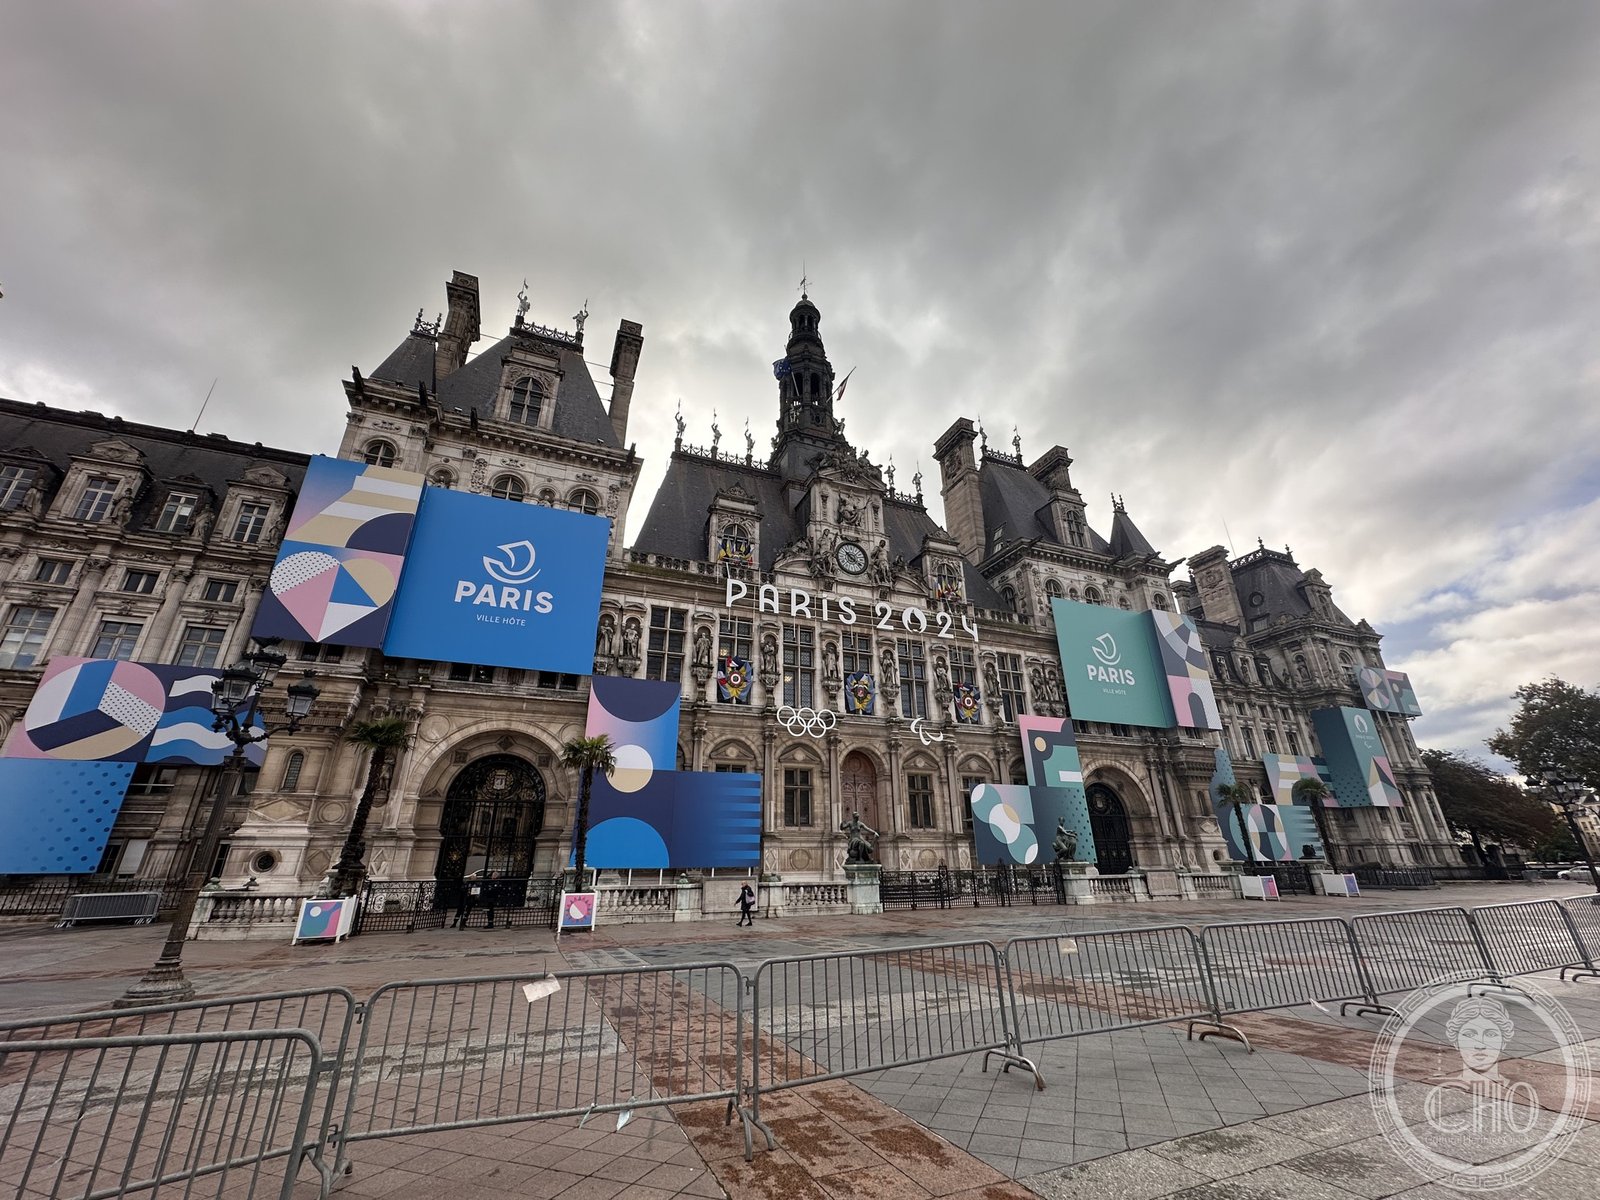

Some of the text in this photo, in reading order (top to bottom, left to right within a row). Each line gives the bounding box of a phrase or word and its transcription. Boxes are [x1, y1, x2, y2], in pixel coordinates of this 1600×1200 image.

[454, 580, 554, 614] PARIS
[726, 579, 979, 643] PARIS 2024
[476, 614, 526, 627] VILLE HÔTE
[1086, 664, 1136, 686] PARIS
